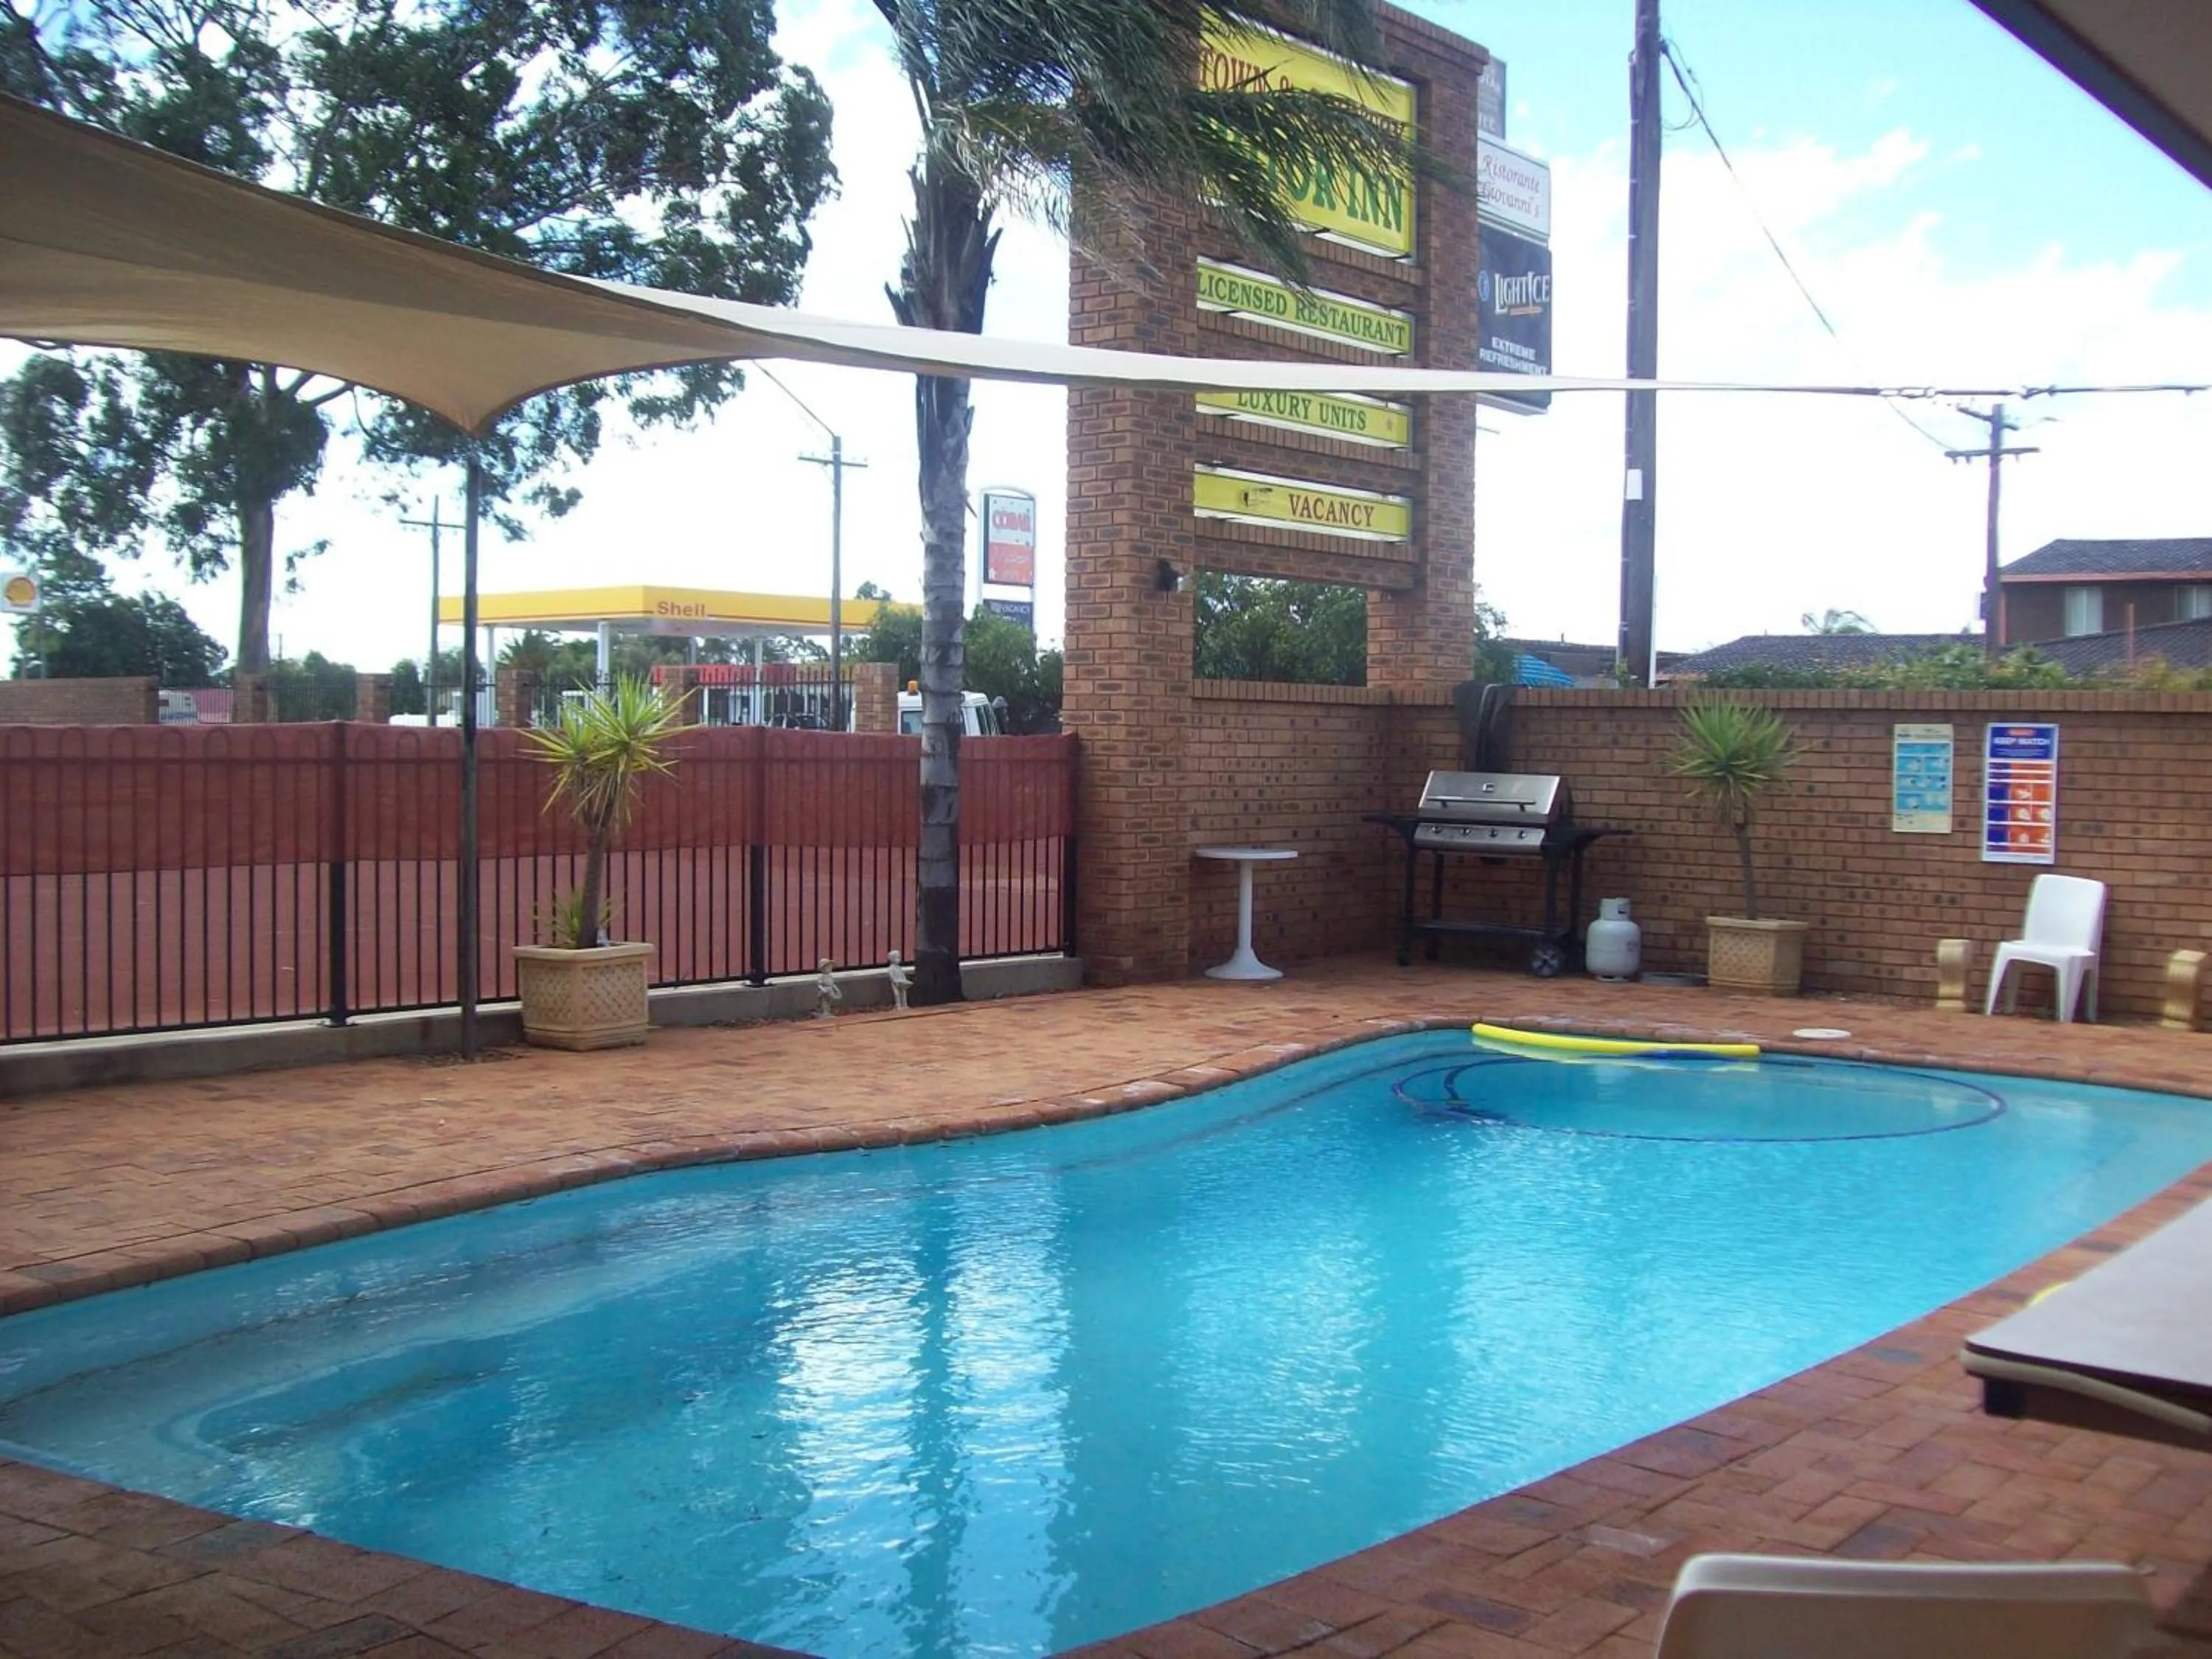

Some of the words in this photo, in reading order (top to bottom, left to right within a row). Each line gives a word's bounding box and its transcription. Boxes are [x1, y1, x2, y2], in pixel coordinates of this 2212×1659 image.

[1483, 154, 1540, 193] Ristorante
[1197, 271, 1287, 316] LICENSED
[1295, 296, 1405, 346] RESTAURANT
[1492, 337, 1537, 361] EXTREME
[1238, 392, 1312, 420] LUXURY
[1319, 404, 1366, 431] UNITS
[1289, 493, 1374, 526] VACANCY
[657, 601, 706, 617] Shell
